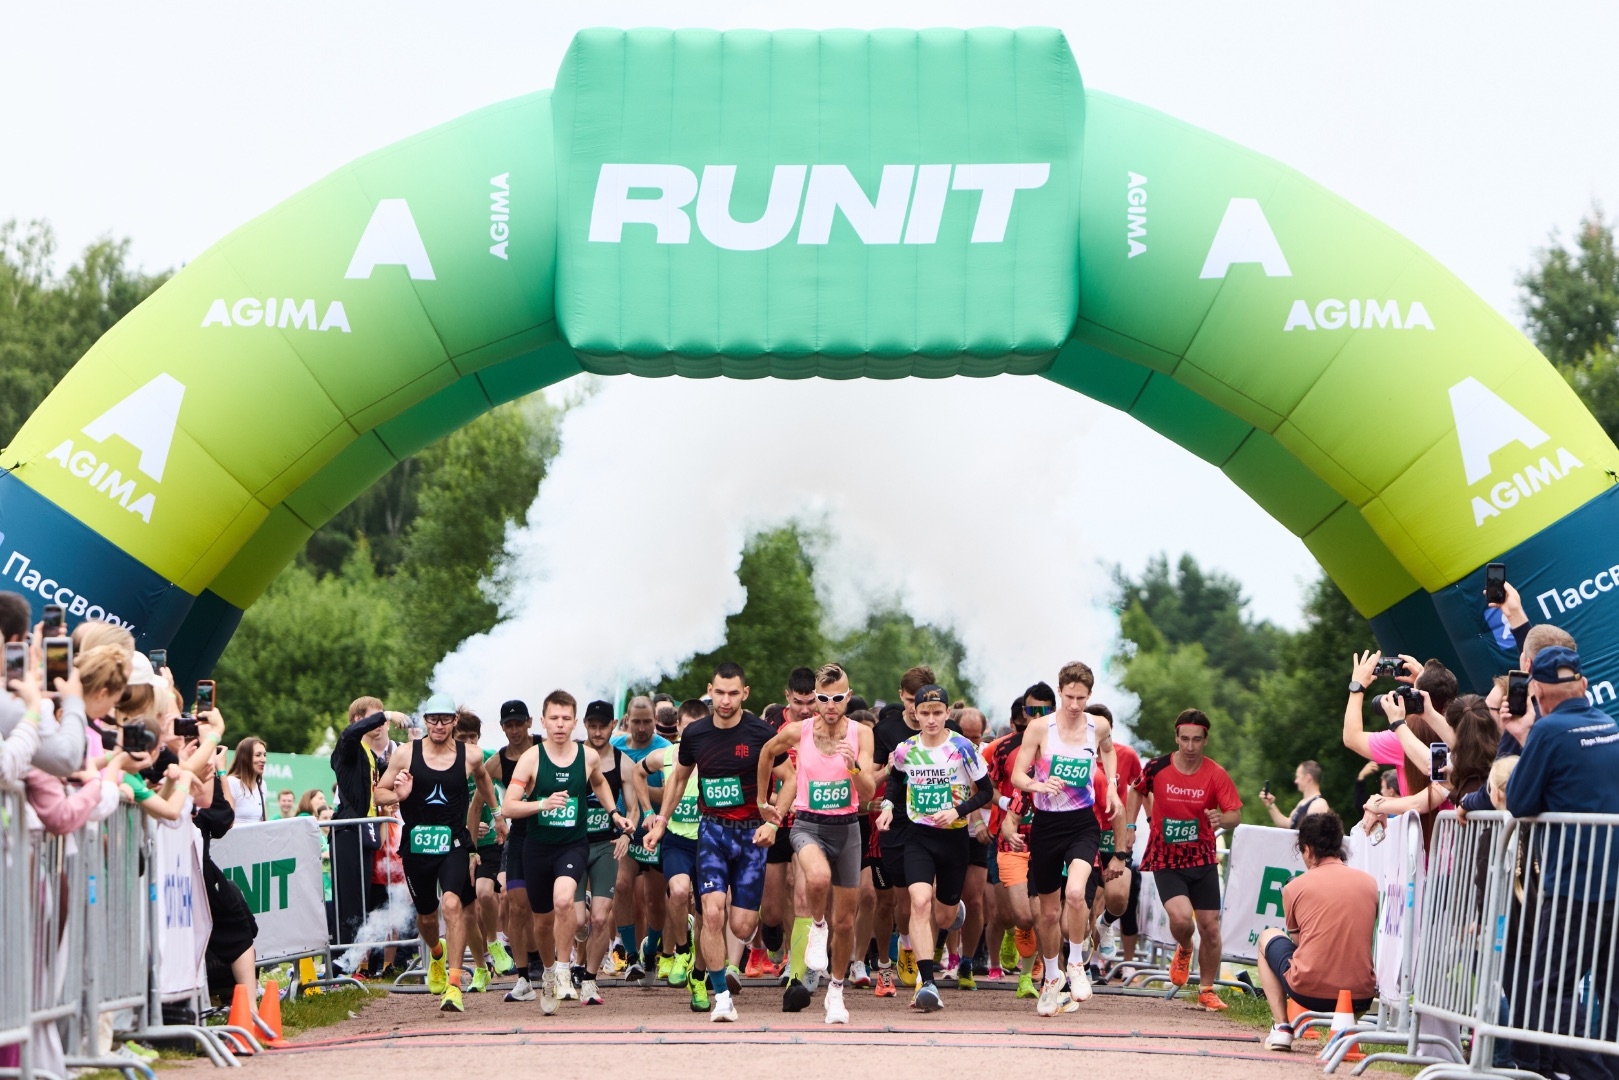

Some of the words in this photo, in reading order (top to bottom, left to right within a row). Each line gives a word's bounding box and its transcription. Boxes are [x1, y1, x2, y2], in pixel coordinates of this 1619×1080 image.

[588, 162, 1051, 251] RUNIT
[1127, 170, 1147, 259] AGIMA
[489, 172, 510, 261] AGIMA
[344, 198, 437, 280] A
[1199, 197, 1293, 279] A
[200, 297, 352, 332] AGIMA
[1283, 298, 1436, 331] AGIMA
[80, 371, 187, 484] A
[1447, 375, 1551, 487] A
[45, 438, 156, 524] AGIMA
[1471, 446, 1585, 528] AGIMA
[262, 763, 293, 779] IMA
[915, 768, 946, 777] РИТМЕ
[1053, 763, 1088, 779] 6550
[706, 784, 740, 799] 6505
[813, 786, 849, 802] 6569
[917, 790, 949, 805] 5731
[1166, 783, 1205, 798] Контур
[674, 802, 698, 815] 531
[586, 812, 609, 825] 499
[414, 833, 449, 846] 6310
[1165, 825, 1197, 837] 5168
[1248, 929, 1259, 946] by
